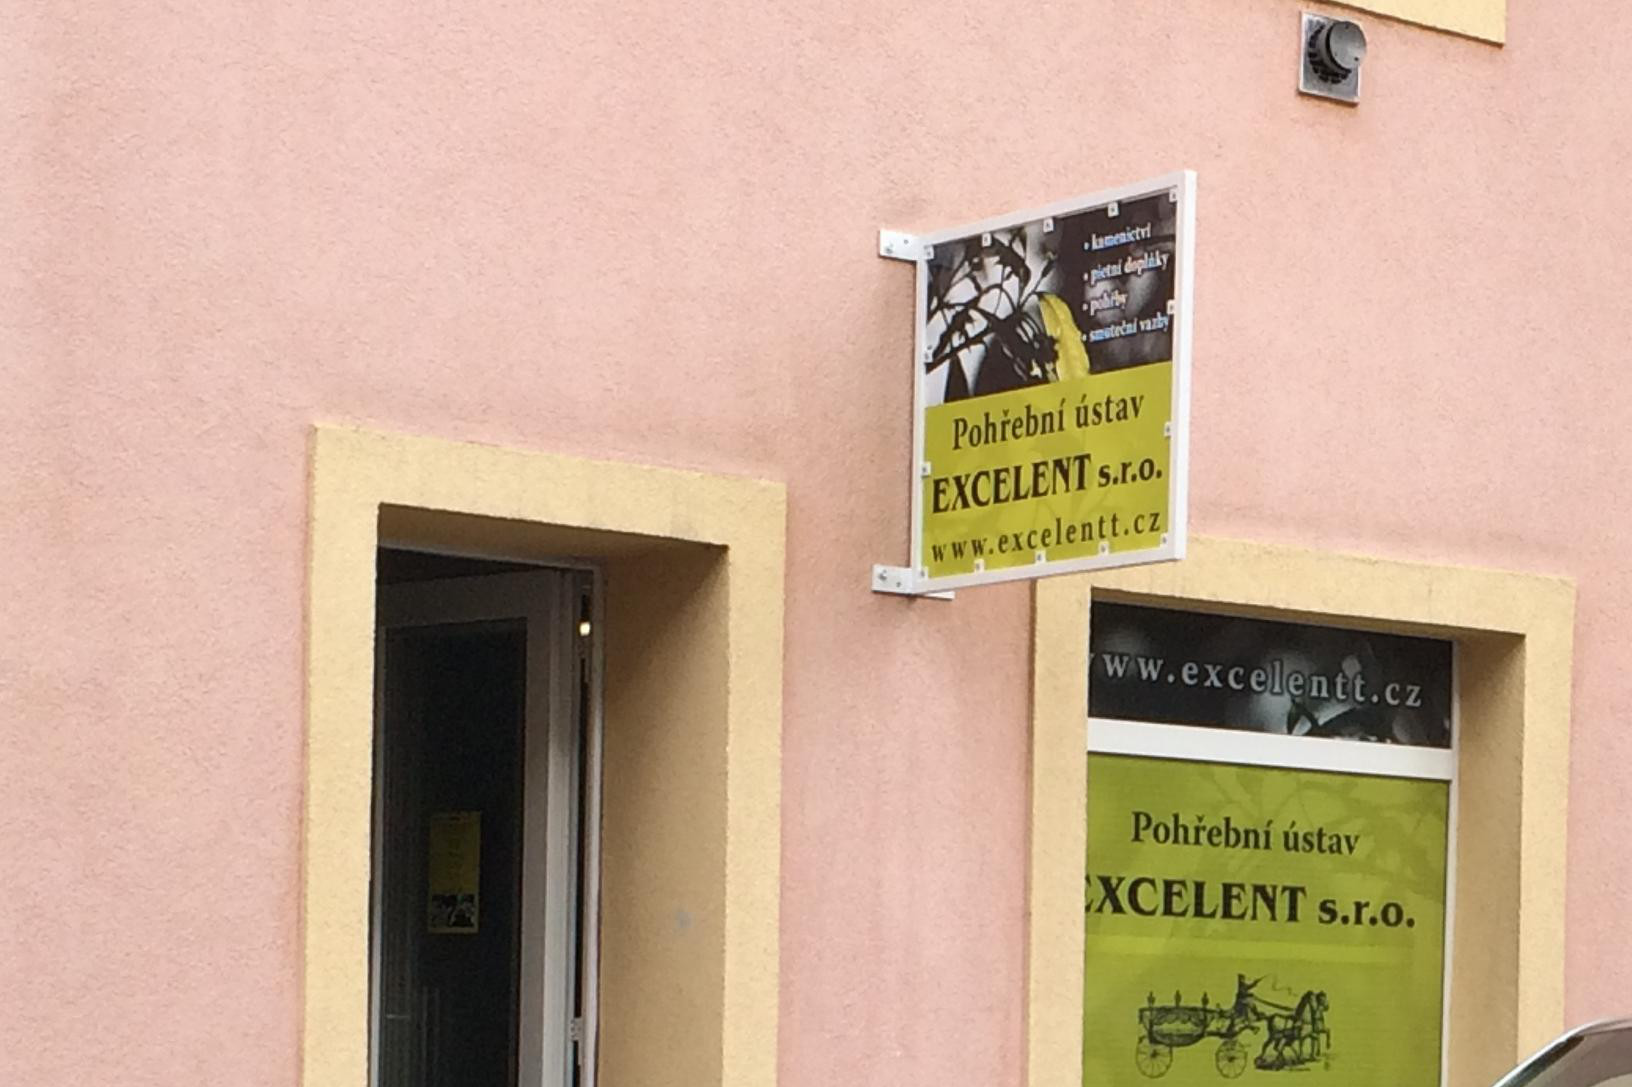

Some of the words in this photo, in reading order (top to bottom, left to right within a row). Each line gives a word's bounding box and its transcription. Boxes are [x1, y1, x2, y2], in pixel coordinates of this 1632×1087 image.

[952, 398, 1066, 450] Pohřební
[1076, 394, 1144, 430] ústav
[931, 453, 1092, 514] EXCELENT
[1097, 457, 1162, 488] s.r.o.
[931, 512, 1161, 563] www.excelentt.cz
[1089, 652, 1422, 708] ww.excelentt.cz
[1131, 810, 1273, 851] Pohřební
[1282, 820, 1360, 856] ústav
[1318, 897, 1416, 928] s.r.o.
